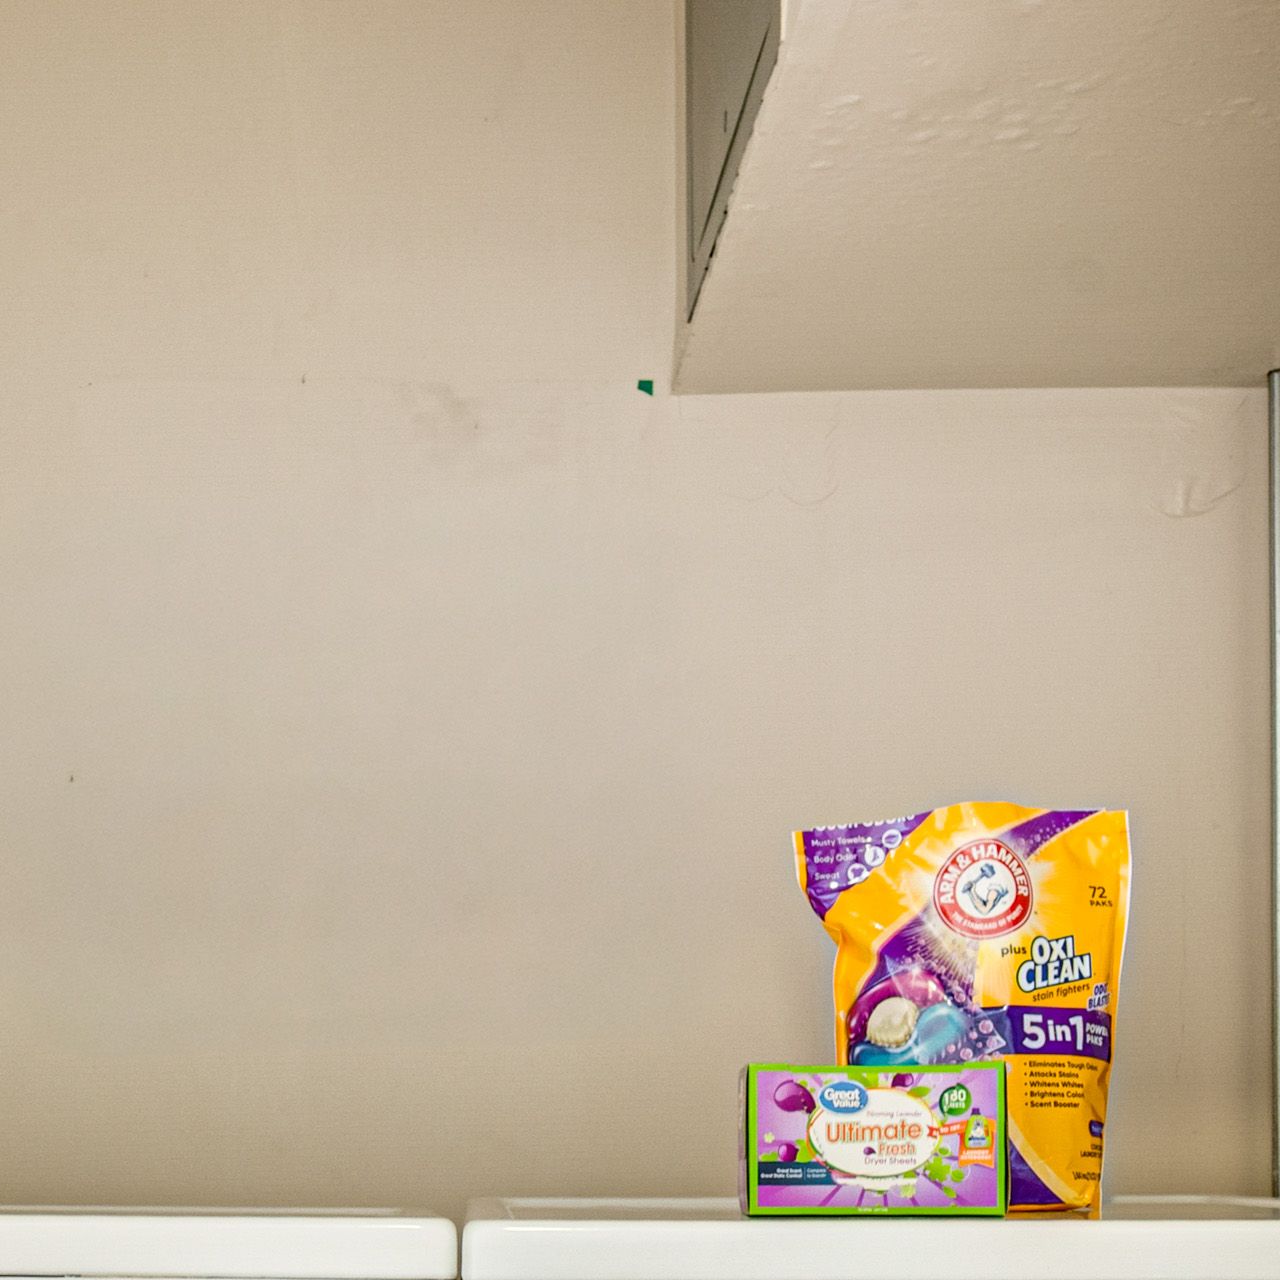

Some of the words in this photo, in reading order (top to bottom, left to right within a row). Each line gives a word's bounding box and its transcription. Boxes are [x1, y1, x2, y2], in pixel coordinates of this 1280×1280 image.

[811, 839, 835, 847] Musty
[838, 836, 865, 845] Towels
[814, 855, 834, 864] Body
[835, 853, 857, 861] Odor
[815, 872, 839, 880] Sweat
[940, 865, 961, 904] ARM
[956, 854, 972, 867] &
[971, 844, 1028, 896] HAMMER
[1089, 886, 1107, 898] 72
[1001, 944, 1027, 957] plus
[1031, 935, 1074, 965] OXI
[1017, 953, 1092, 992] CLEAN
[1033, 991, 1054, 1001] stain
[1056, 984, 1090, 997] fighters
[1068, 1062, 1084, 1070] Tough
[824, 1087, 860, 1100] Great
[833, 1099, 860, 1109] Value
[826, 1120, 923, 1143] Ultimate
[878, 1142, 915, 1156] Fresh
[864, 1157, 888, 1166] Dryer
[890, 1156, 917, 1165] Sheets
